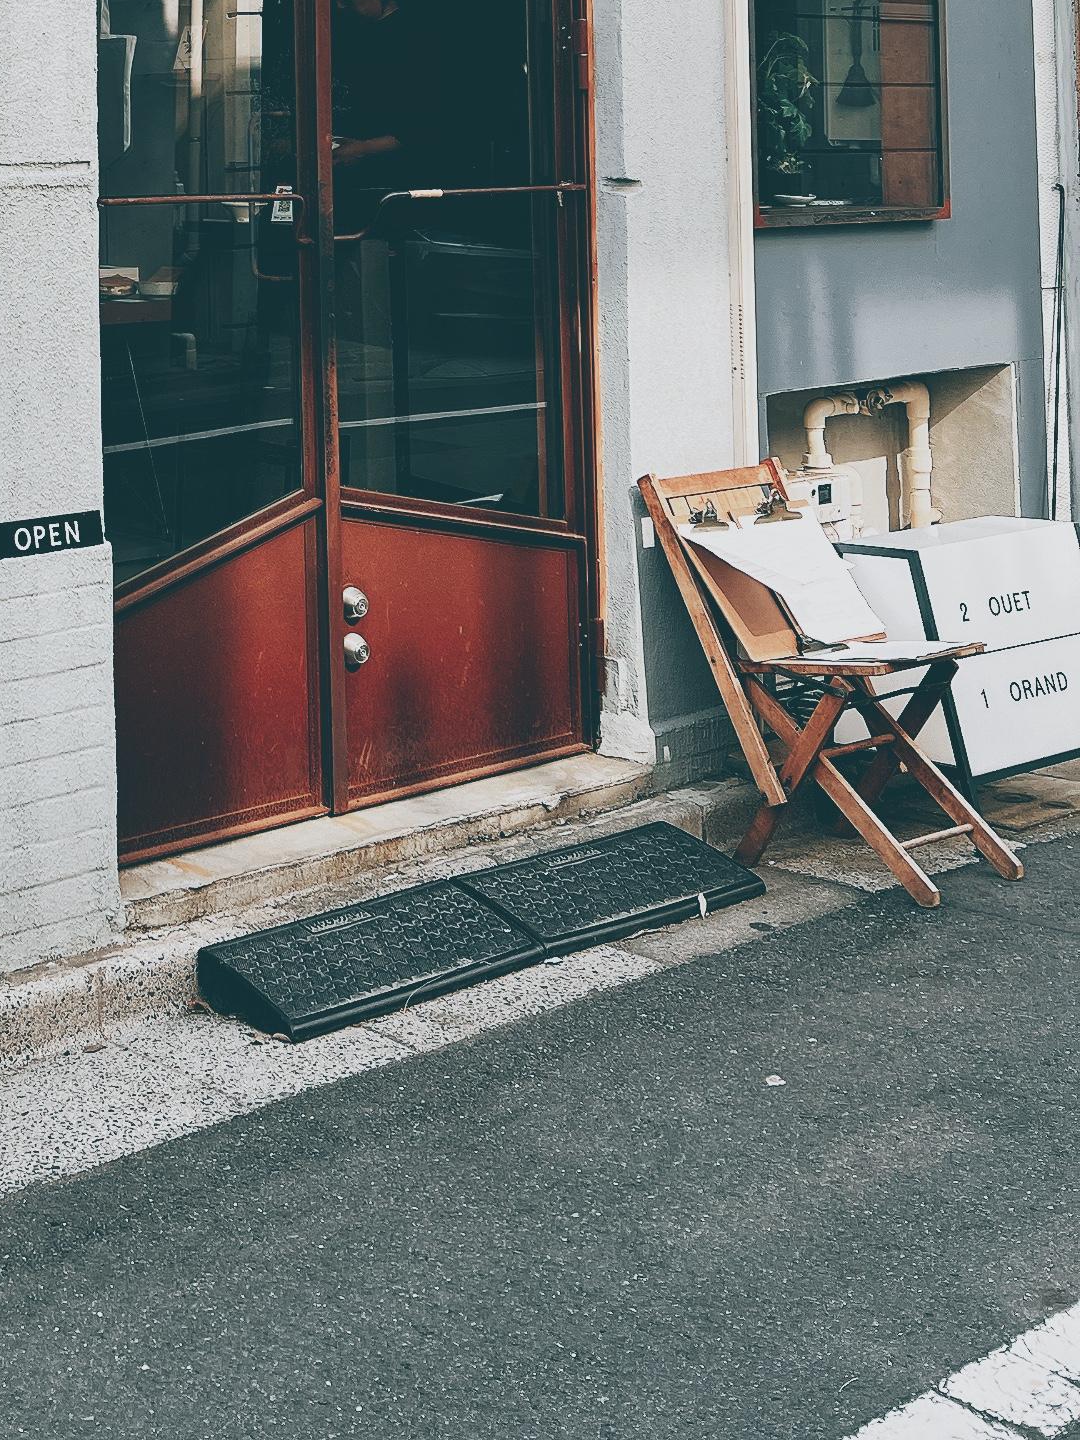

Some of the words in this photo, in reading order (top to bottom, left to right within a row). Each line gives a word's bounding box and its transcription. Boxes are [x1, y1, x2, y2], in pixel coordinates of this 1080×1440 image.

[14, 520, 81, 551] OPEN
[959, 602, 970, 622] 2
[988, 590, 1031, 616] OUET
[980, 688, 989, 709] 1
[1009, 671, 1068, 702] ORAND
